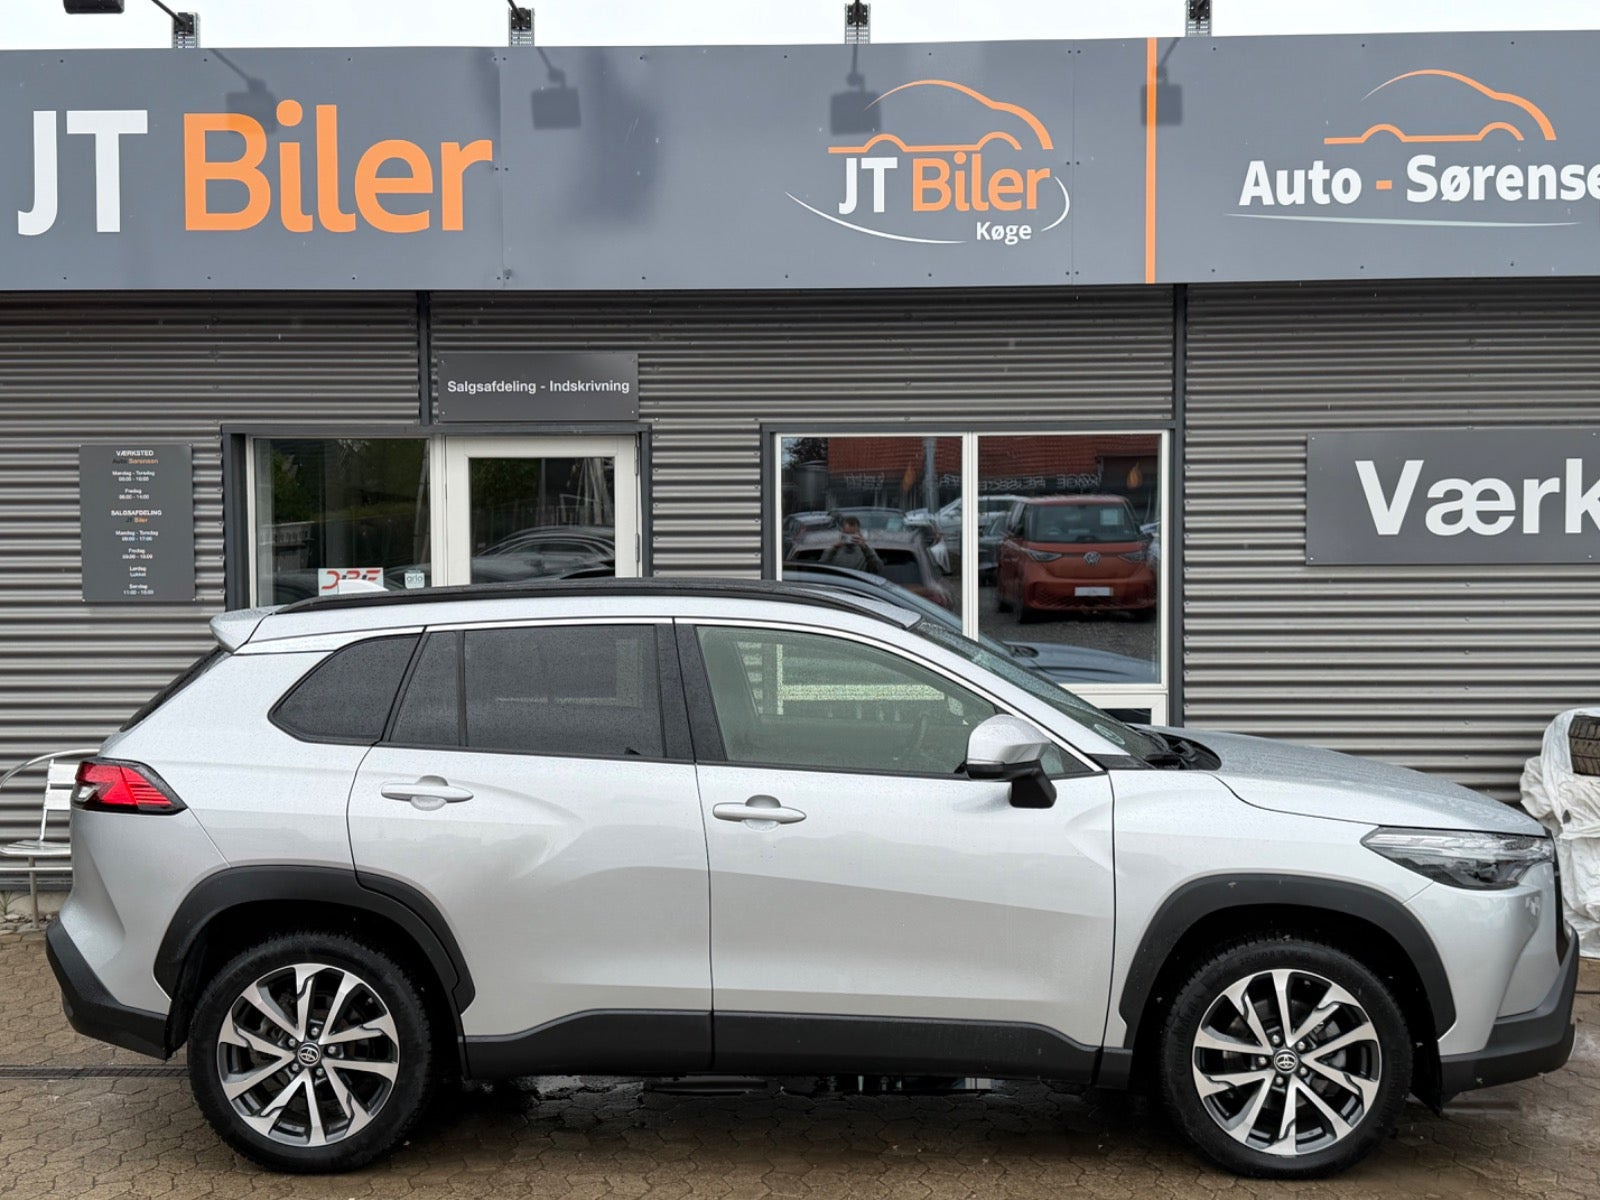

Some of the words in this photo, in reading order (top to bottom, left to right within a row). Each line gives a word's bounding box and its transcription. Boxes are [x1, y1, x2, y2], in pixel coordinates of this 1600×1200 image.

[17, 109, 148, 236] JT
[183, 98, 494, 234] Biler
[838, 156, 898, 215] JT
[911, 151, 1051, 212] Biler
[1238, 159, 1363, 206] Auto
[975, 221, 1033, 245] Køge
[447, 380, 537, 395] Salgsafdeling
[549, 380, 630, 394] Indskrivning
